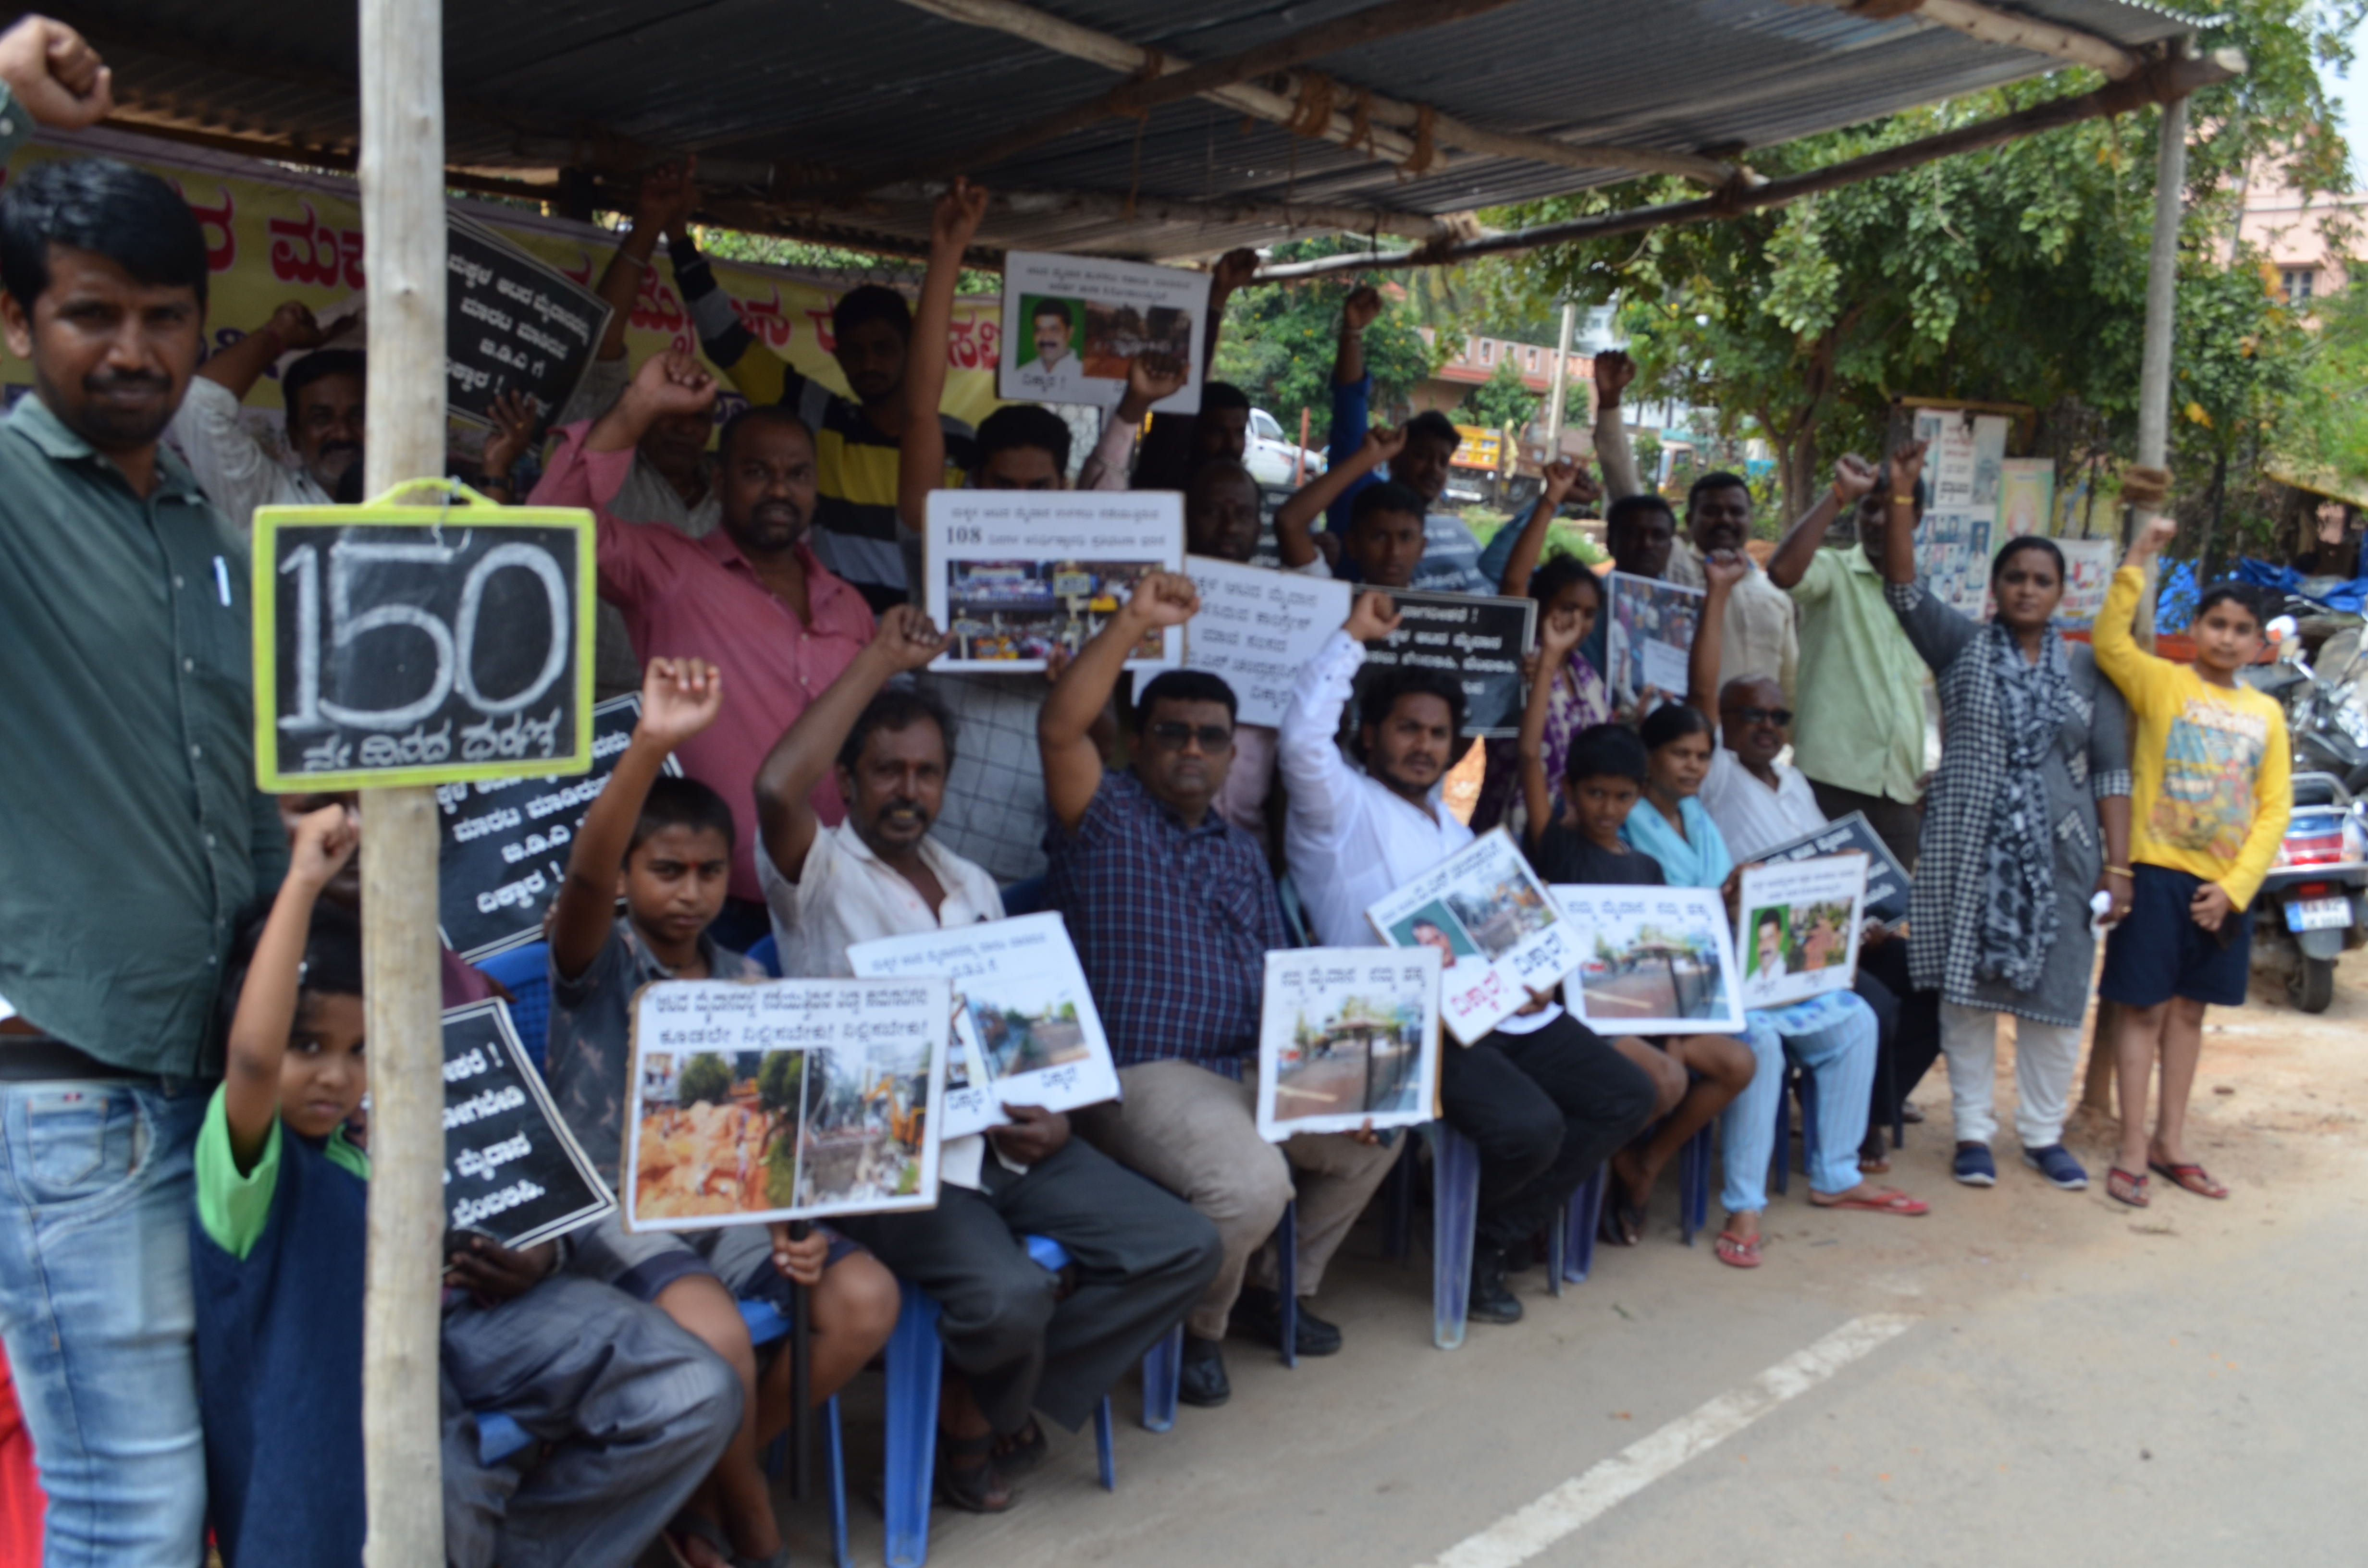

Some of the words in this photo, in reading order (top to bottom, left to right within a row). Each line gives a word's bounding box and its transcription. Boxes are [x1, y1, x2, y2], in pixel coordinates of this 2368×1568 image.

[947, 526, 982, 545] 108
[1267, 586, 1317, 612] ಮೈದಾನ
[278, 542, 570, 731] 150
[1452, 632, 1503, 653] ಮೈದಾನ
